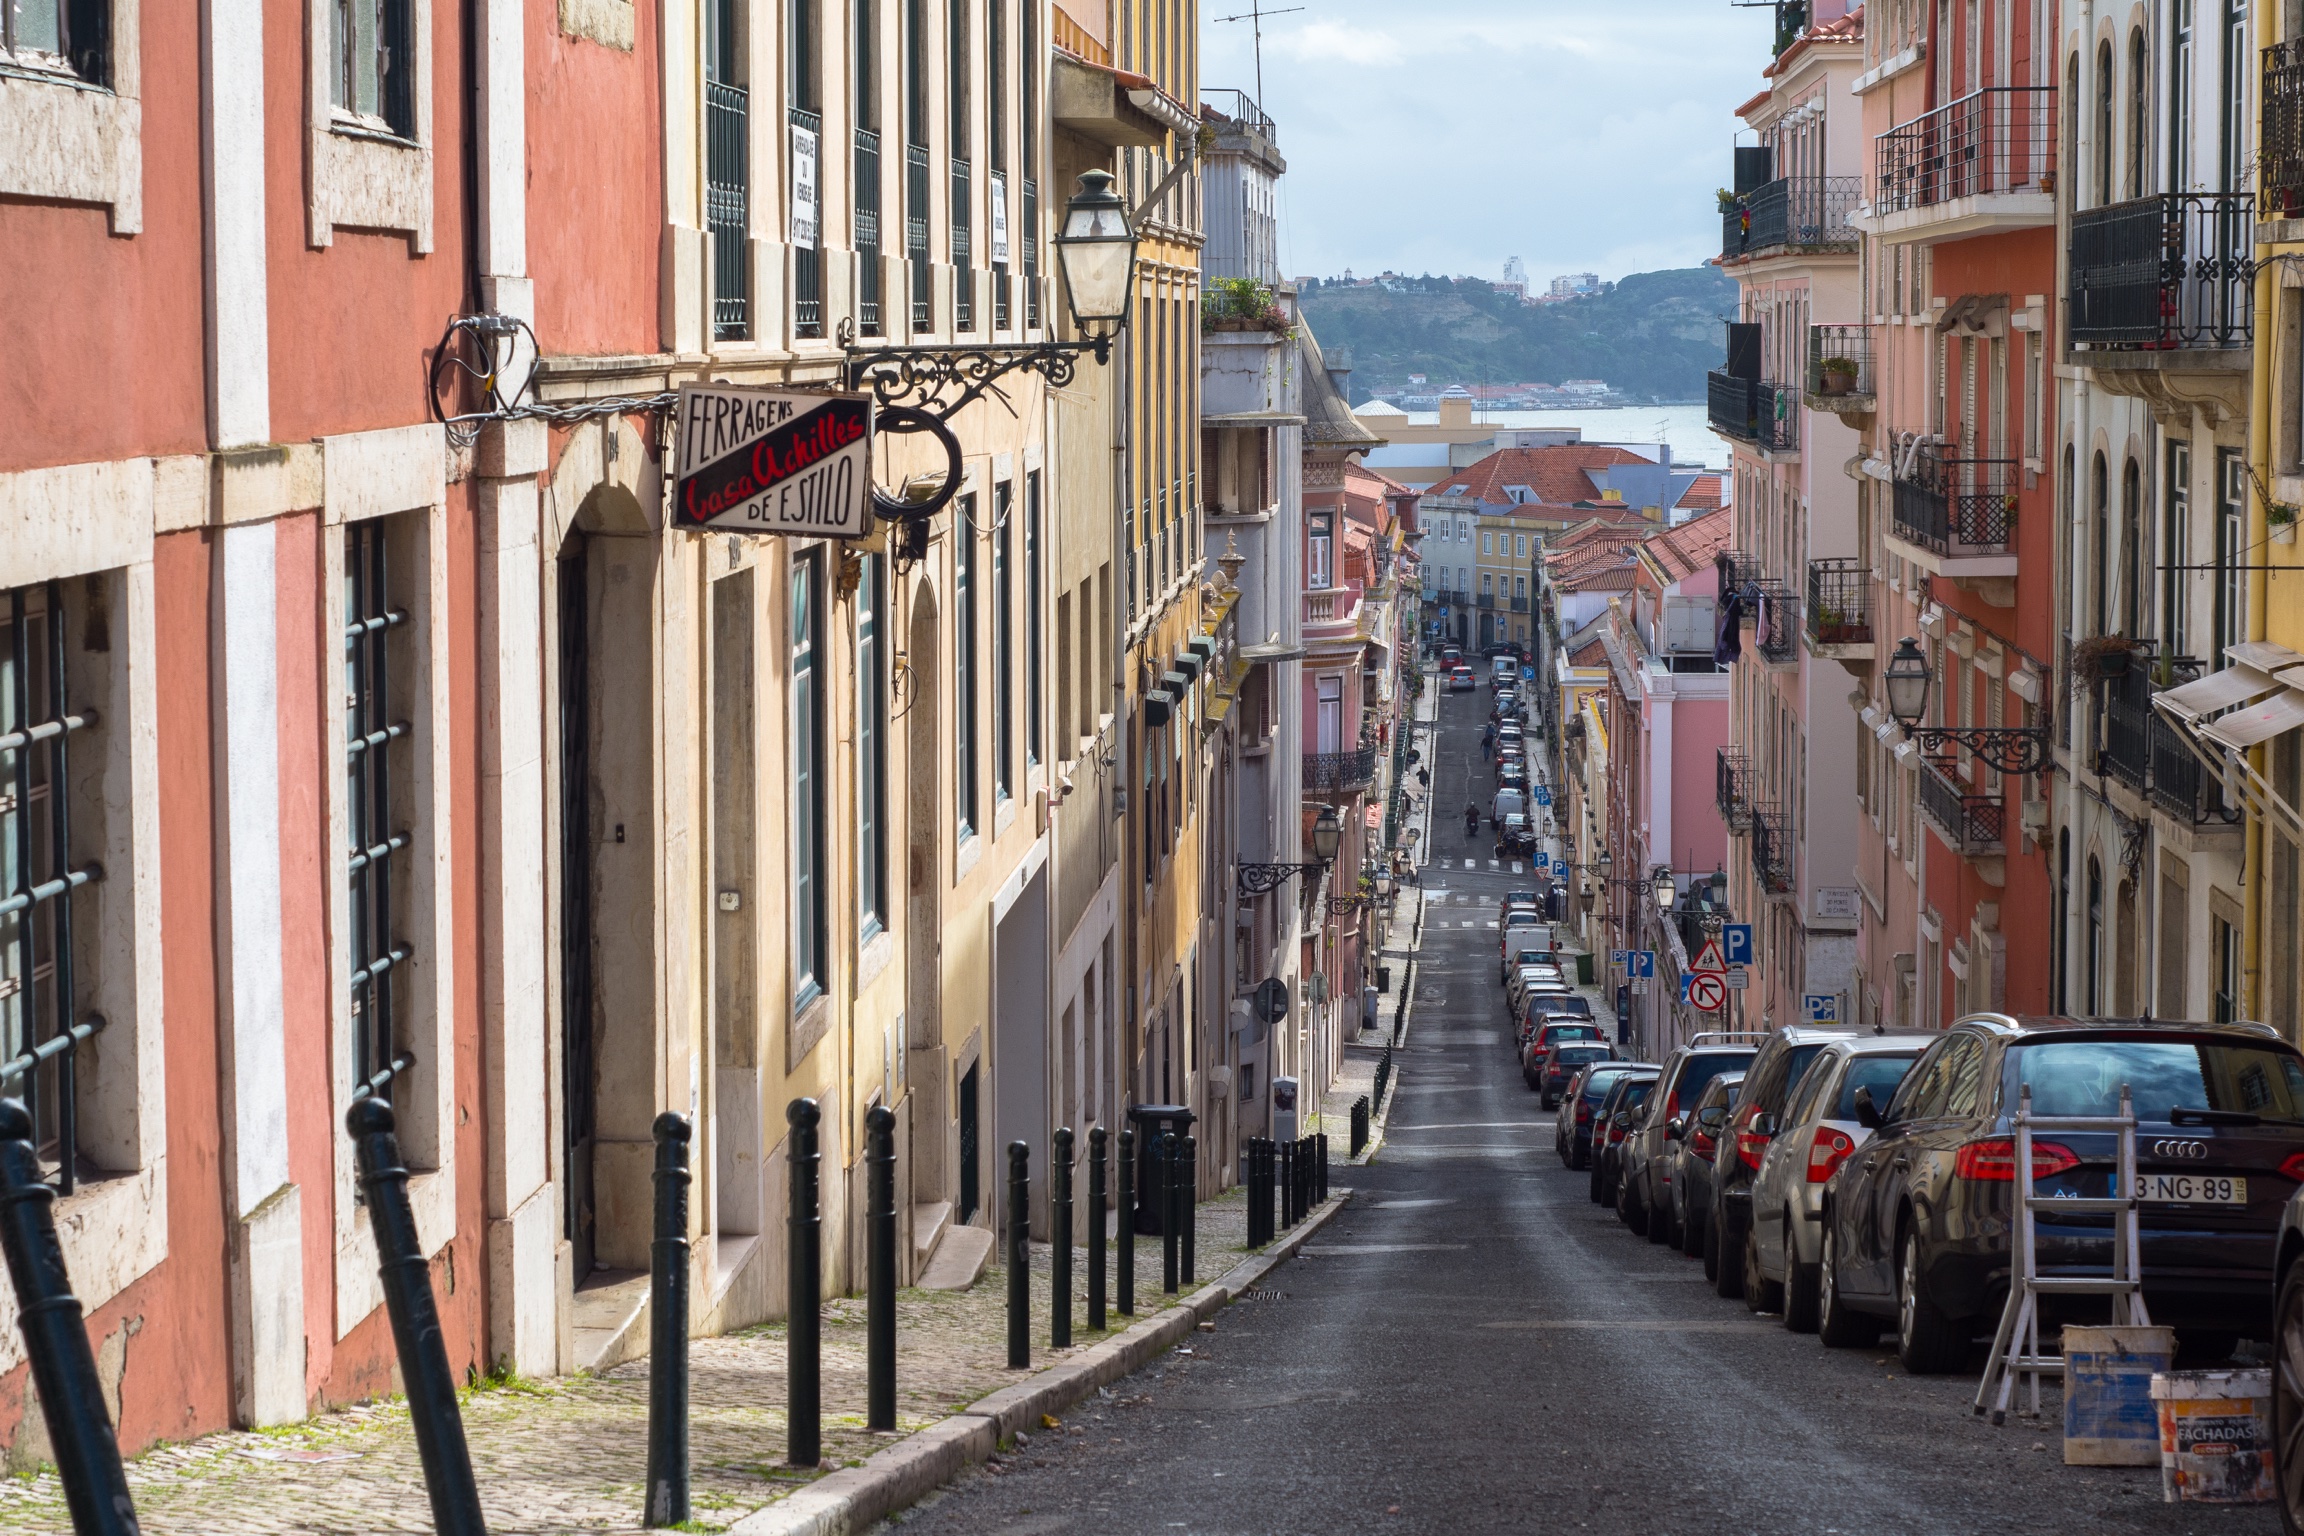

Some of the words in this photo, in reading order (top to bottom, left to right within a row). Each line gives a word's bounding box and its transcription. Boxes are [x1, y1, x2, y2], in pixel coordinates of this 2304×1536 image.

[686, 393, 794, 471] FERRAGENS
[686, 476, 756, 522] Casa
[751, 412, 865, 487] Achilles
[748, 493, 773, 522] DE
[780, 454, 851, 526] ESTILO
[1541, 794, 1548, 804] P
[1537, 854, 1545, 866] P
[1555, 862, 1563, 874] P
[1728, 930, 1744, 959] P
[1633, 954, 1648, 974] P
[1808, 997, 1822, 1019] P
[2236, 1180, 2244, 1188] 12
[2236, 1192, 2244, 1200] 10
[2178, 1428, 2254, 1440] FACHADAS
